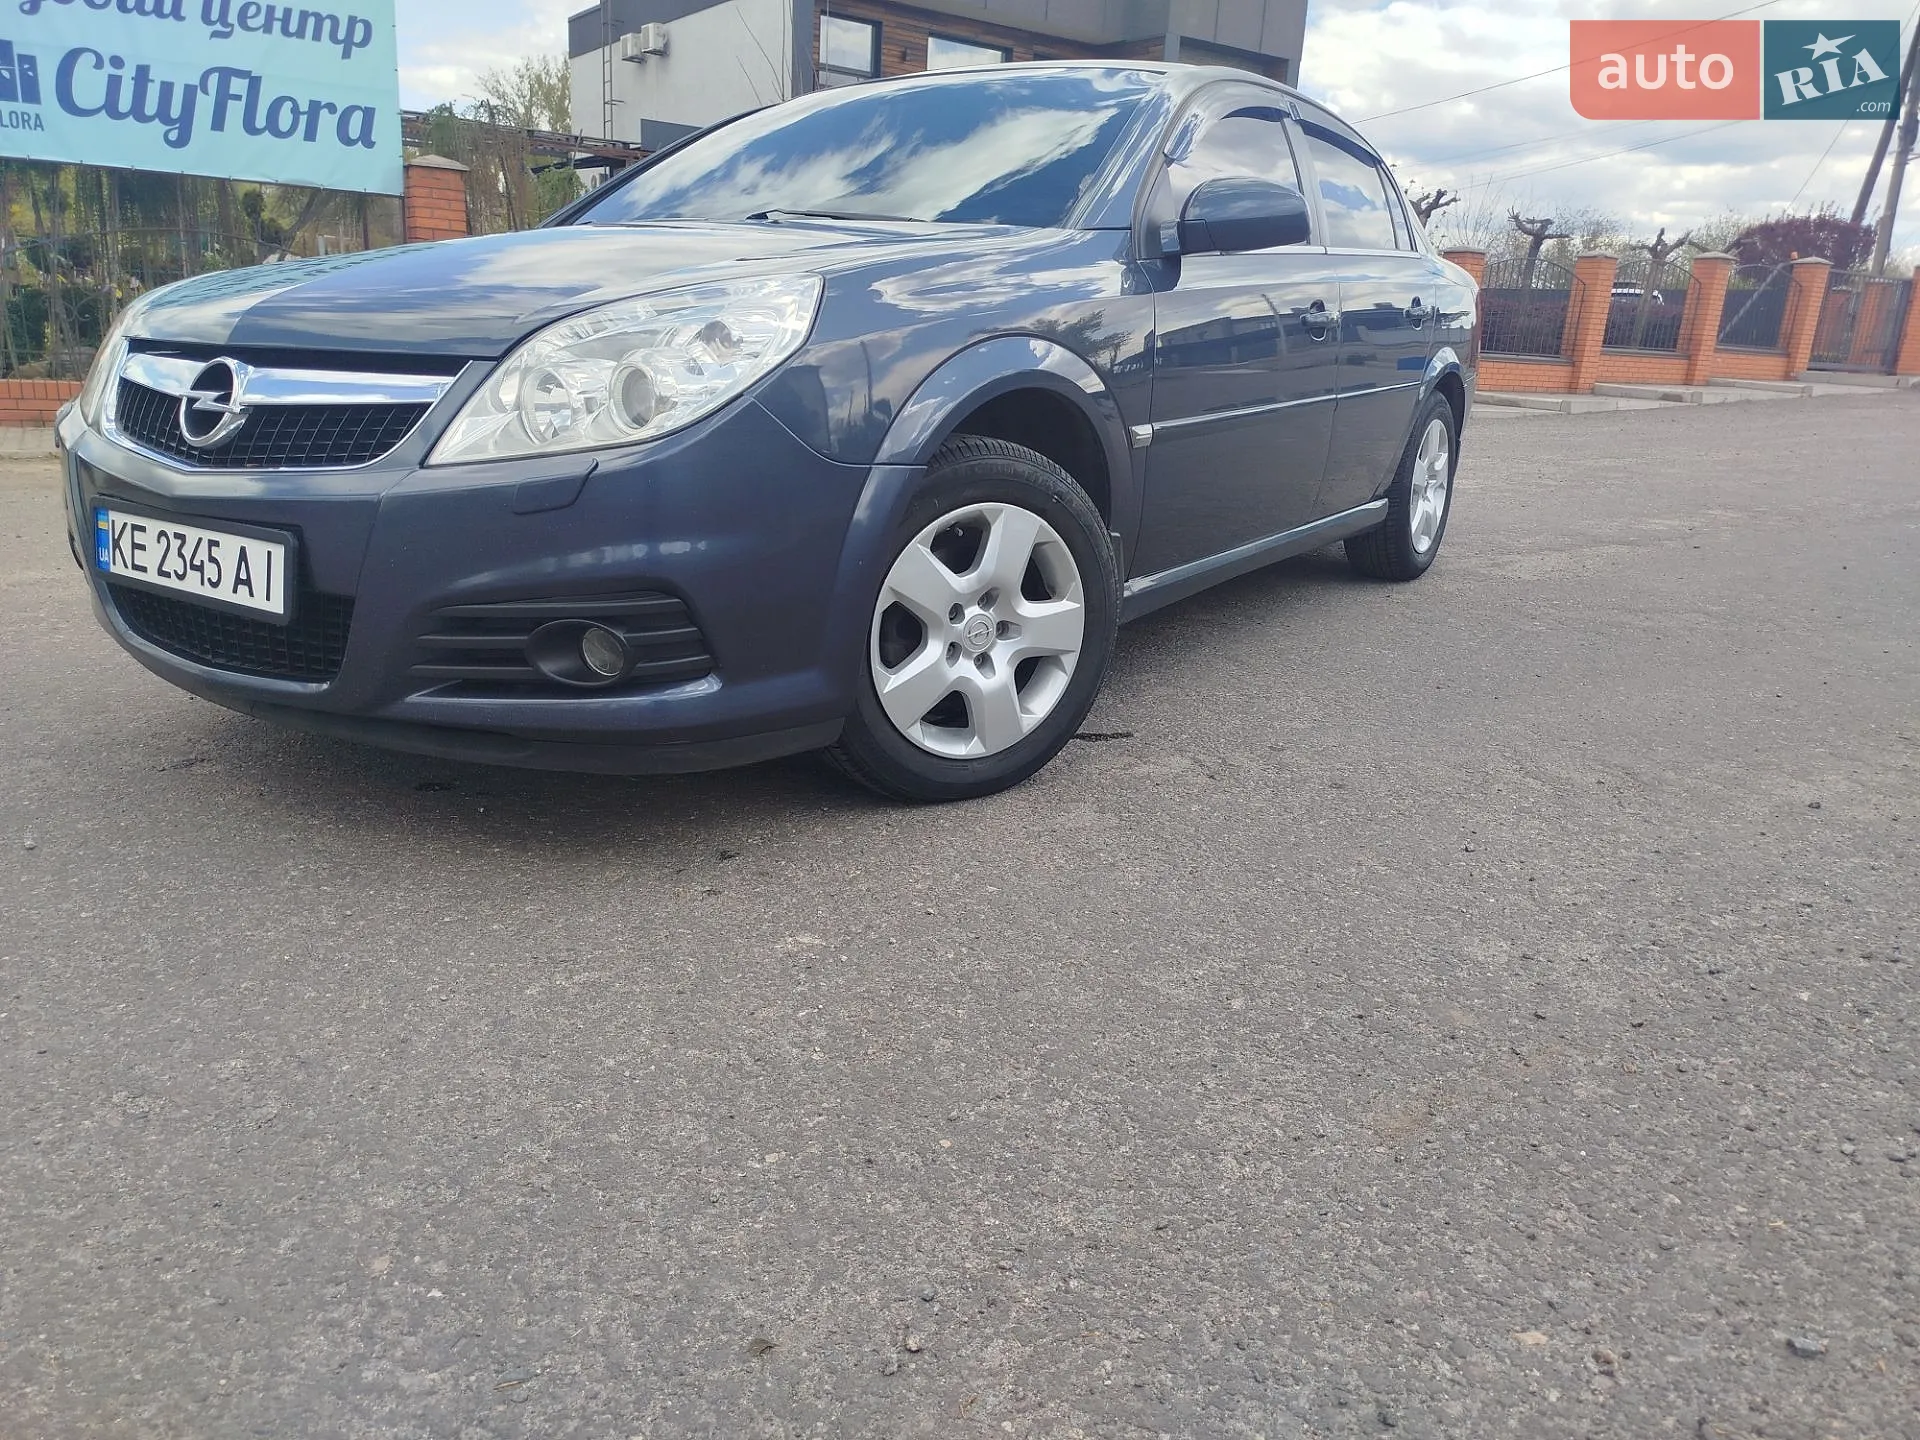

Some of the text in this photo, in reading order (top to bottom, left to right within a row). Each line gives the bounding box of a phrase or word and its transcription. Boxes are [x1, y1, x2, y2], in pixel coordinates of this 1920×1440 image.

[201, 0, 373, 60] центр
[55, 47, 376, 149] CityFlora
[99, 547, 109, 562] UA
[111, 519, 148, 574] KE
[156, 529, 222, 589] 2345
